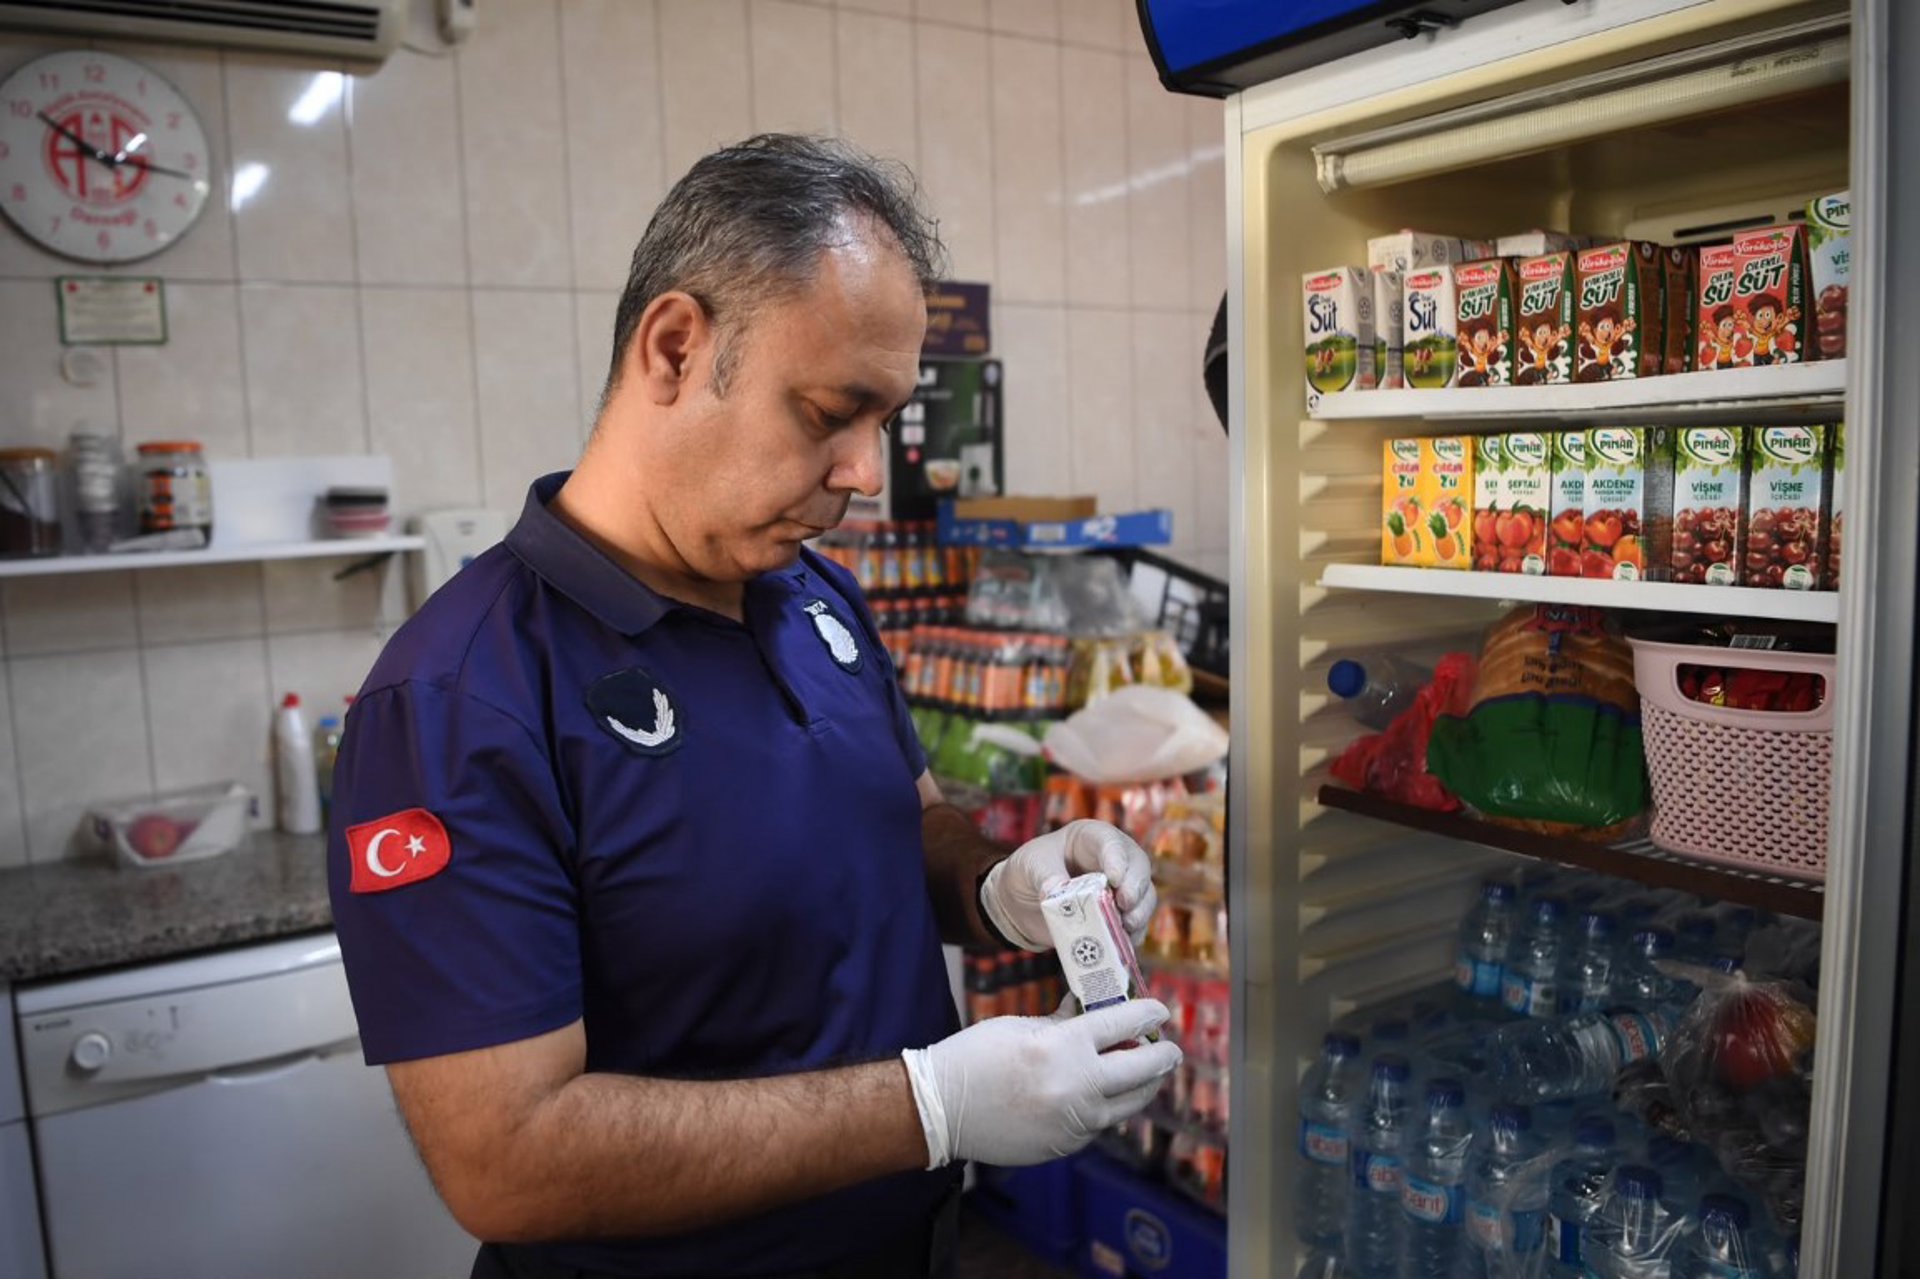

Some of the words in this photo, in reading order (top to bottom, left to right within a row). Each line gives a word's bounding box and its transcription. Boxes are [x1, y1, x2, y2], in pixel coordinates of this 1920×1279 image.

[84, 64, 106, 82] 12
[1737, 264, 1786, 295] SÜT
[1460, 294, 1495, 320] SÜT
[1522, 287, 1560, 315] SÜT
[1581, 279, 1622, 309] SÜT
[1309, 300, 1337, 334] Süt
[1409, 299, 1437, 331] Süt
[1770, 434, 1811, 449] PINAR
[1508, 478, 1541, 489] ŞEFTALİ
[1691, 480, 1724, 495] VİŞNE
[1770, 479, 1804, 495] VİŞNE
